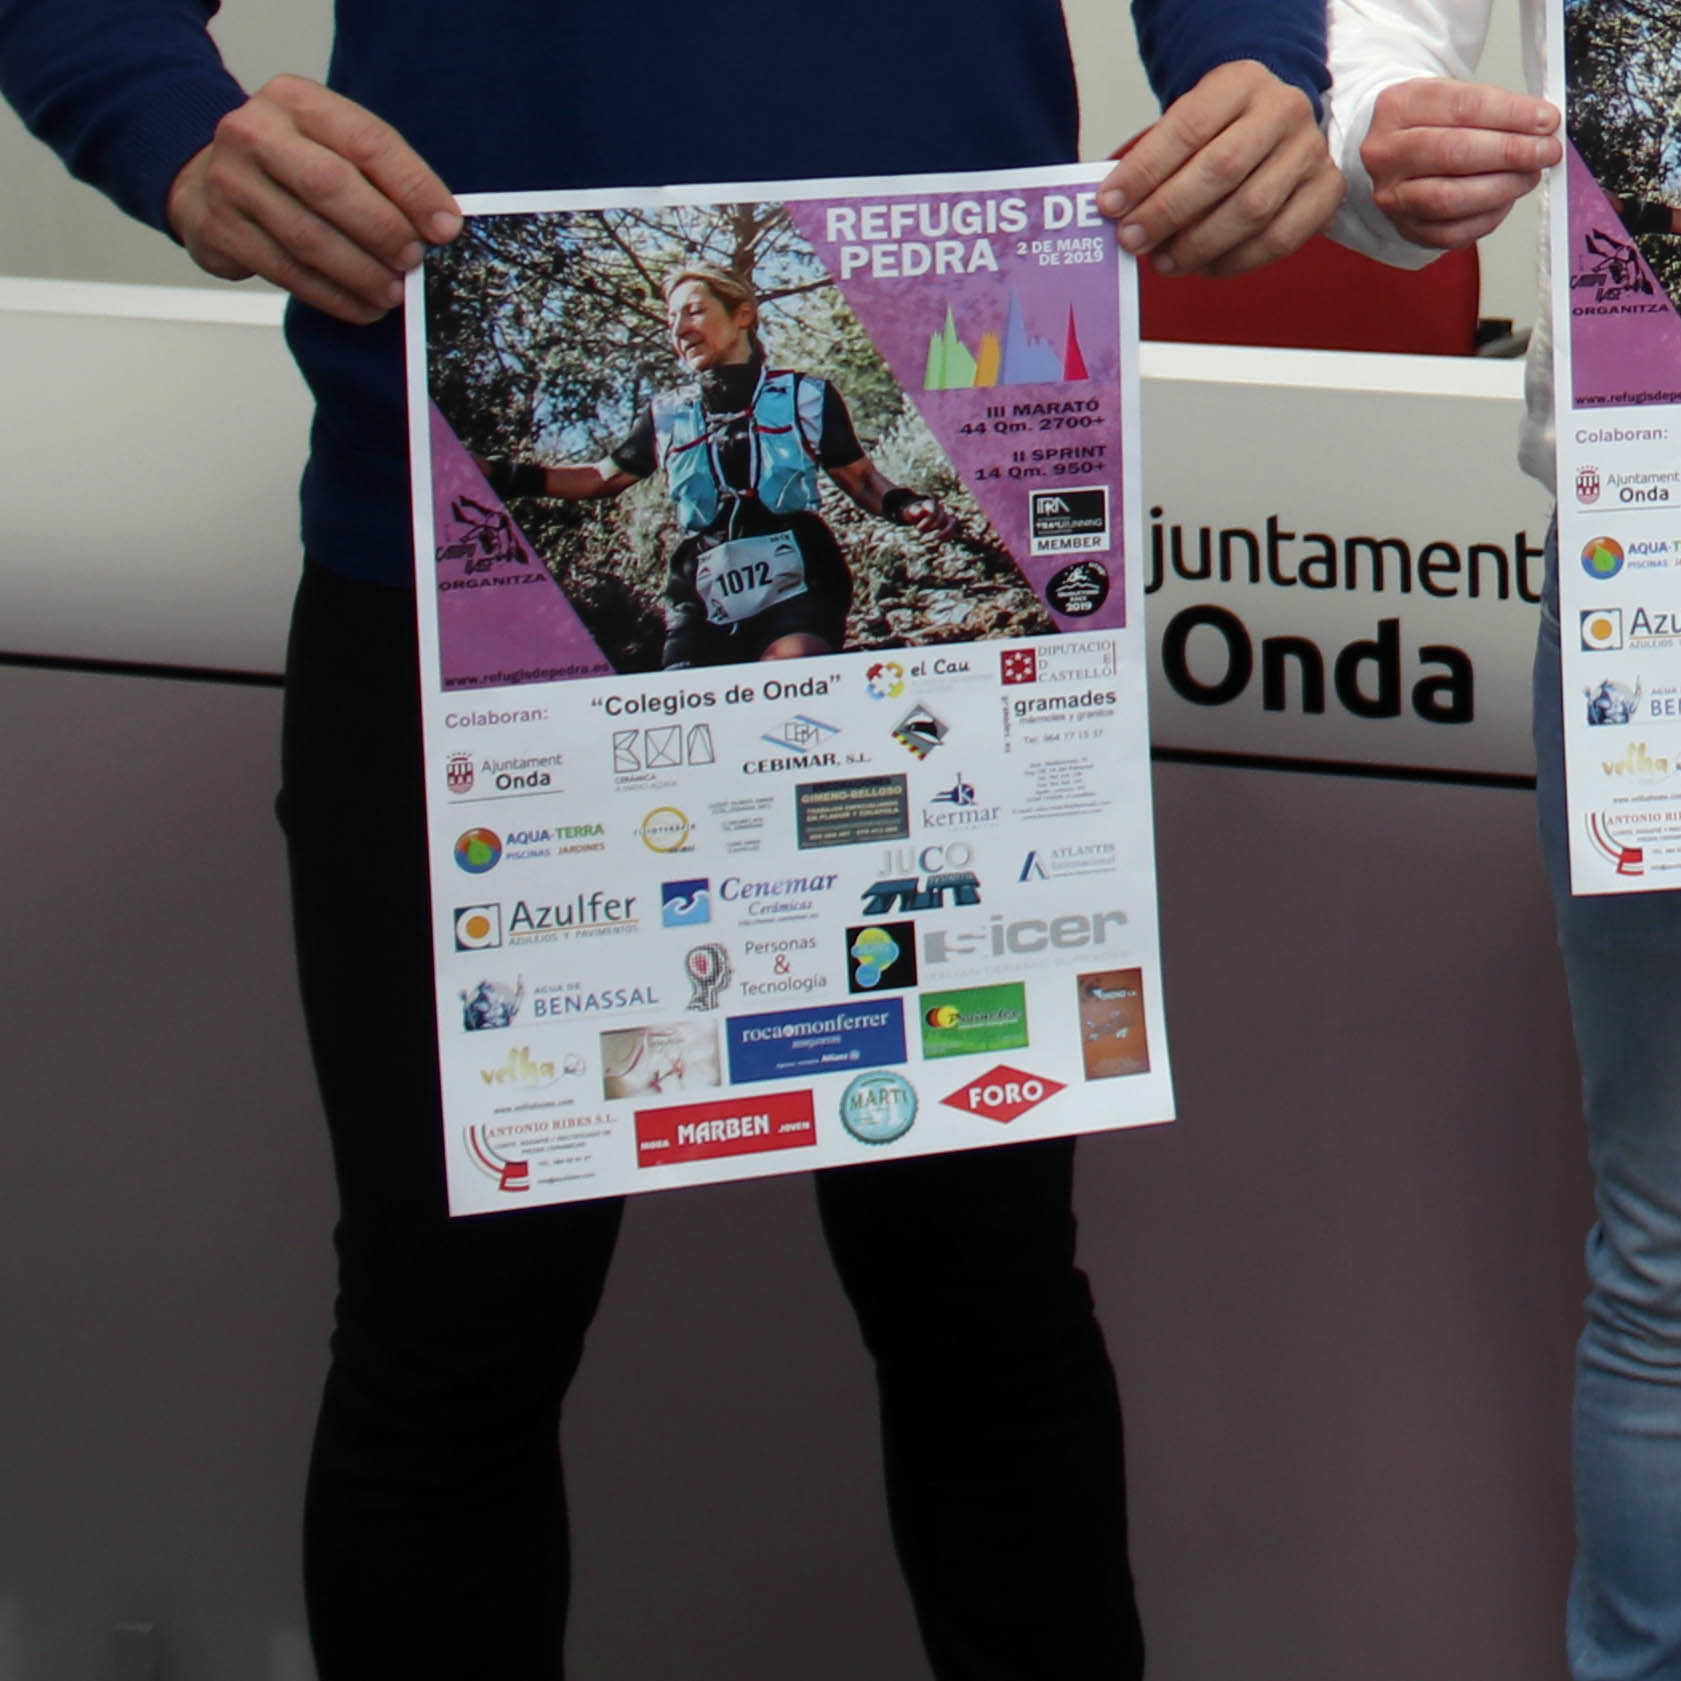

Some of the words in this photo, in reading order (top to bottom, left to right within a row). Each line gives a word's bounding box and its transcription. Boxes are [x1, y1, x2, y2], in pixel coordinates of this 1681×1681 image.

[826, 198, 1028, 242] REFUGIS
[1043, 191, 1104, 230] DE
[1016, 241, 1028, 255] 2
[1032, 240, 1053, 254] DE
[1039, 252, 1060, 266] DE
[1064, 250, 1104, 265] 2019
[840, 238, 999, 280] PEDRA
[1572, 303, 1670, 317] ORGANITZA
[986, 405, 1006, 419] III
[1012, 398, 1099, 417] MARATÓ
[960, 422, 987, 435] 44
[1039, 416, 1105, 432] 2700+
[1575, 427, 1670, 444] Colaboran:
[1013, 450, 1026, 462] II
[1031, 446, 1107, 462] SPRINT
[975, 467, 1001, 481] 14
[1053, 461, 1106, 477] 950+
[1607, 469, 1680, 486] Ajuntament
[1619, 485, 1670, 503] Onda
[1037, 537, 1102, 550] MEMBER
[1144, 505, 1545, 604] juntament
[438, 573, 547, 591] ORGANITZA
[716, 561, 773, 596] 1072
[911, 660, 927, 677] el
[933, 659, 972, 676] Cau
[1162, 604, 1475, 723] Onda
[591, 691, 716, 717] “Colegios
[724, 682, 756, 706] de
[763, 673, 842, 702] Onda”
[1014, 689, 1118, 717] gramades
[445, 707, 550, 730] Colaboran:
[481, 754, 564, 774] Ajuntament
[495, 770, 552, 791] Onda
[922, 805, 1001, 829] kermar
[719, 873, 839, 900] Cenemar
[508, 892, 637, 932] Azulfer
[745, 936, 816, 956] Personas
[773, 954, 791, 975] &
[740, 975, 829, 997] Tecnología
[533, 985, 660, 1018] BENASSAL
[968, 1079, 1045, 1110] FORO
[677, 1113, 770, 1146] MARBEN
